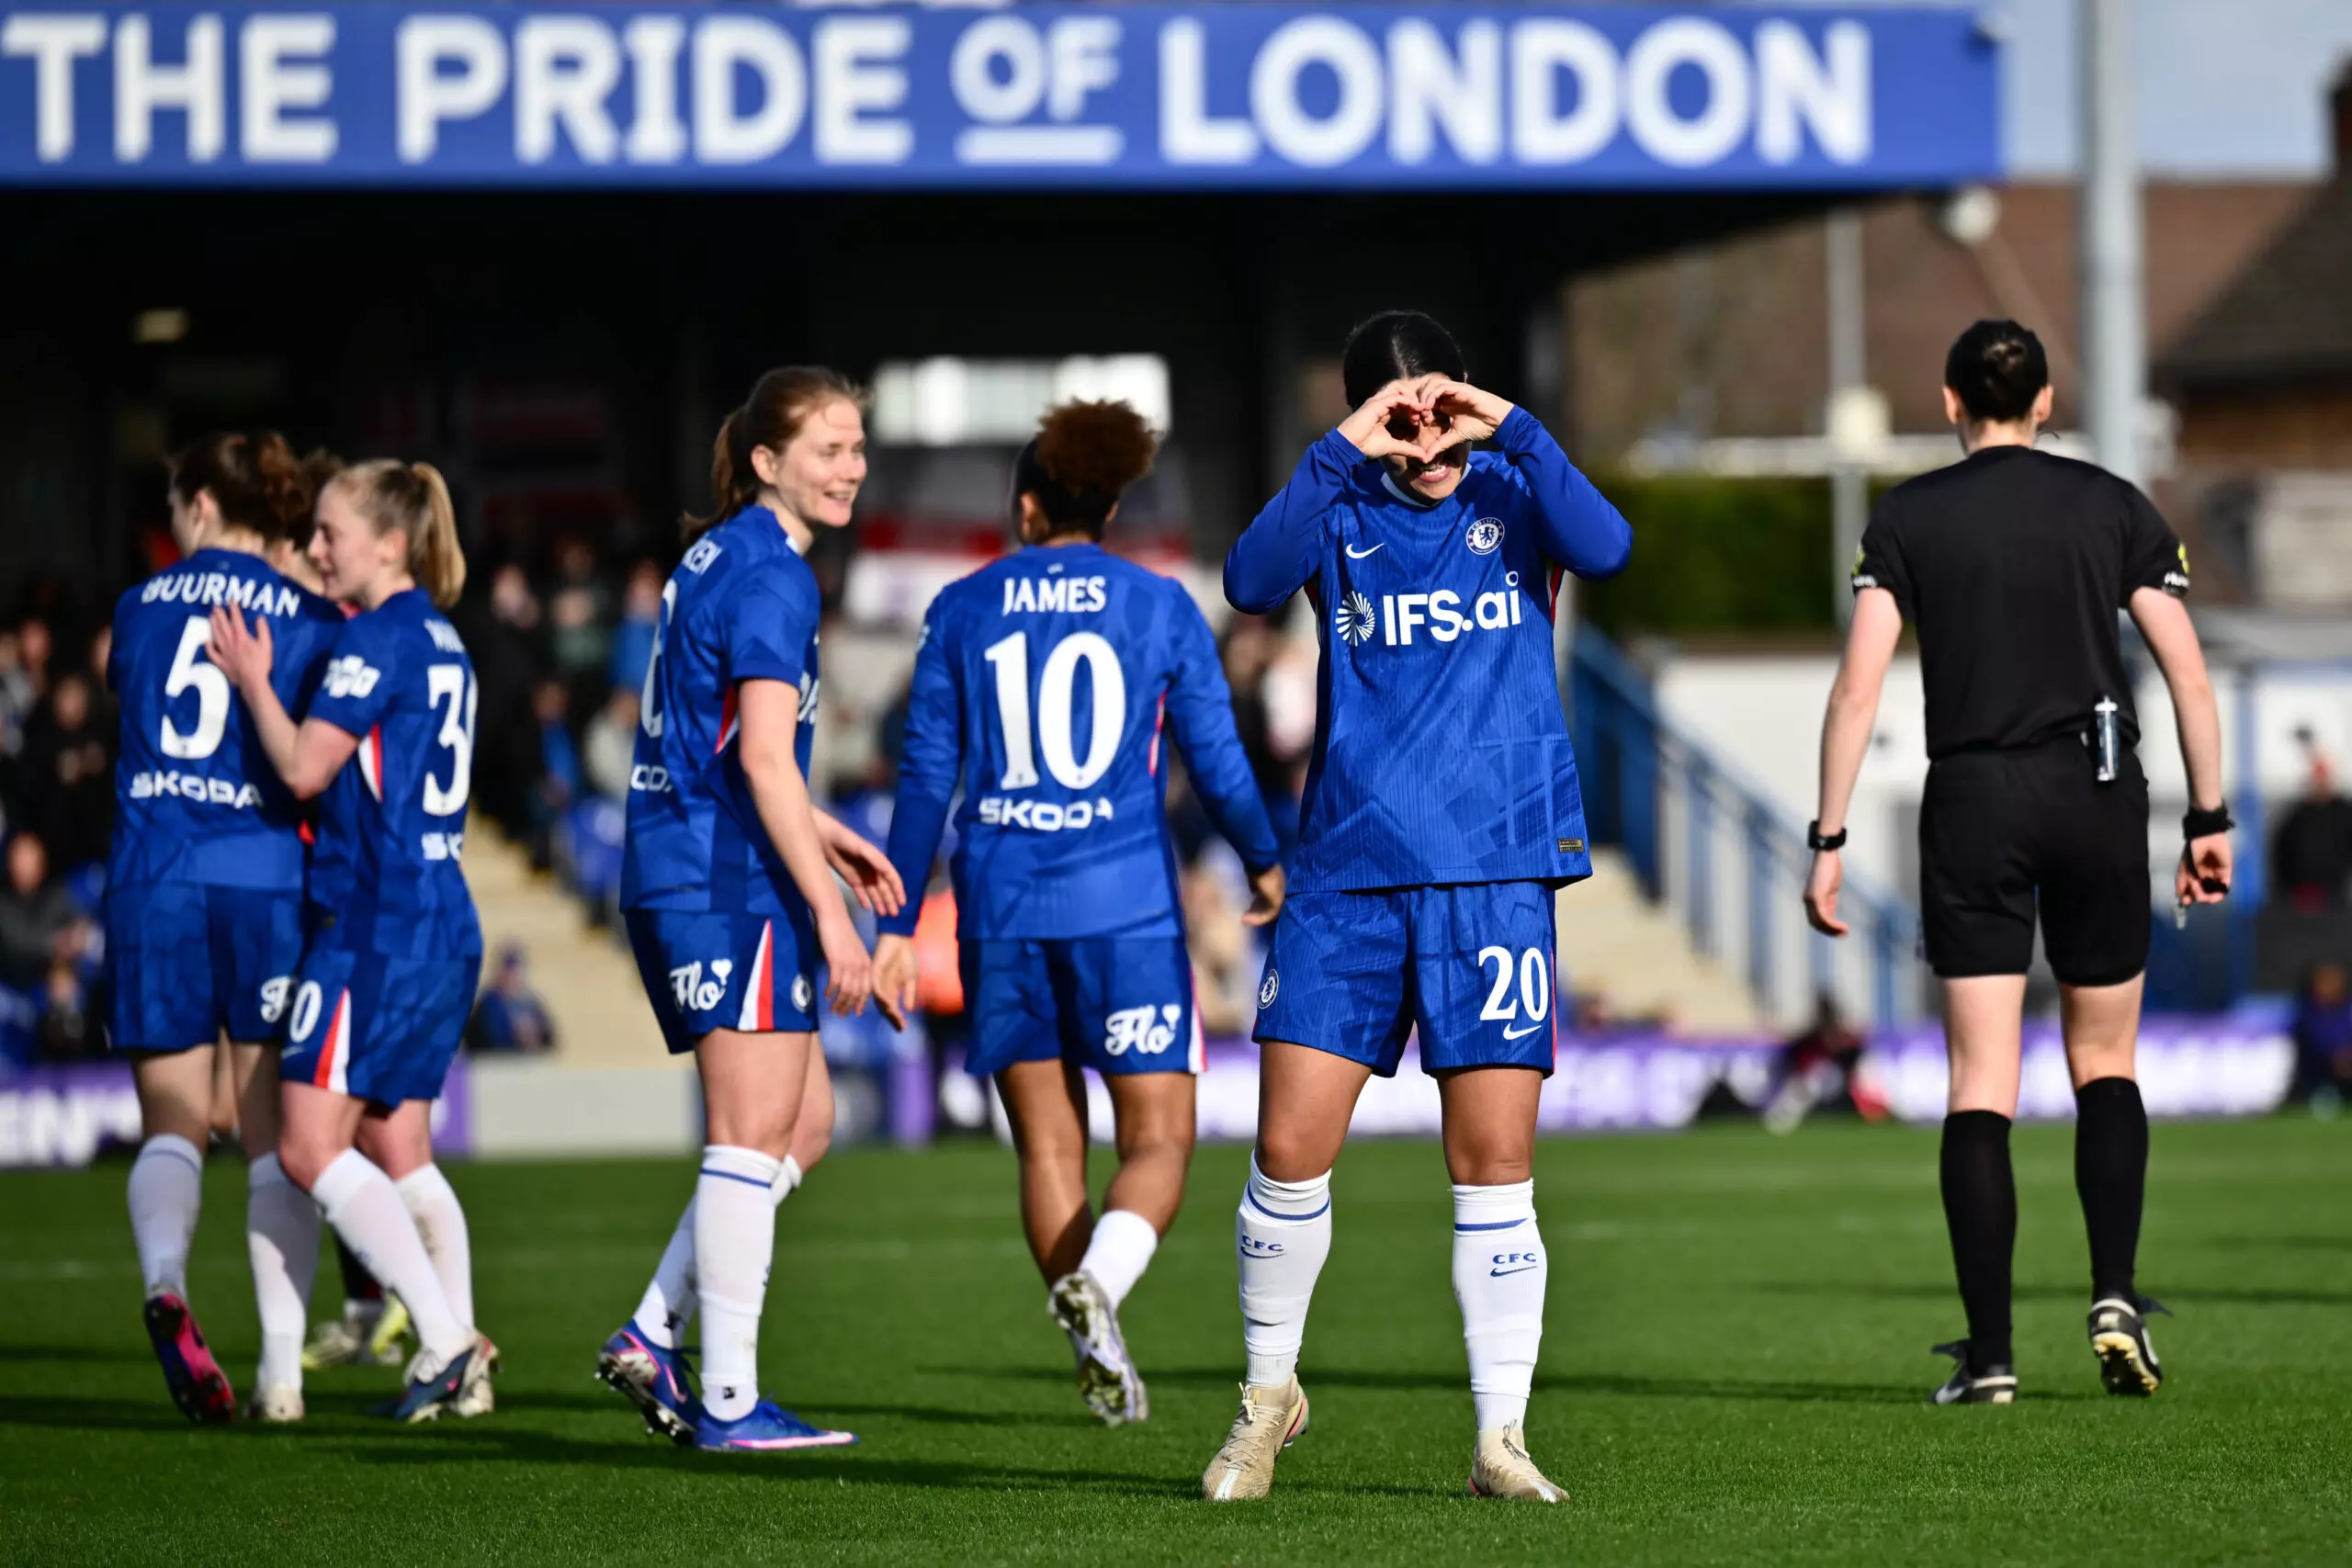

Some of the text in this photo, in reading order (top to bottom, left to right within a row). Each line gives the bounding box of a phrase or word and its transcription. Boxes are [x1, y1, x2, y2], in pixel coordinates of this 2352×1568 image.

[0, 13, 1872, 168] THE PRIDE OF LONDON
[141, 572, 300, 619] BUURMAN
[1001, 575, 1106, 616] JAMES
[1383, 570, 1521, 646] IFS.ai
[161, 615, 230, 760] 5
[984, 630, 1125, 790] 10
[1478, 945, 1548, 1021] 20
[1104, 1004, 1180, 1056] Flo
[1241, 1235, 1284, 1252] CFC
[1492, 1252, 1537, 1264] CFC
